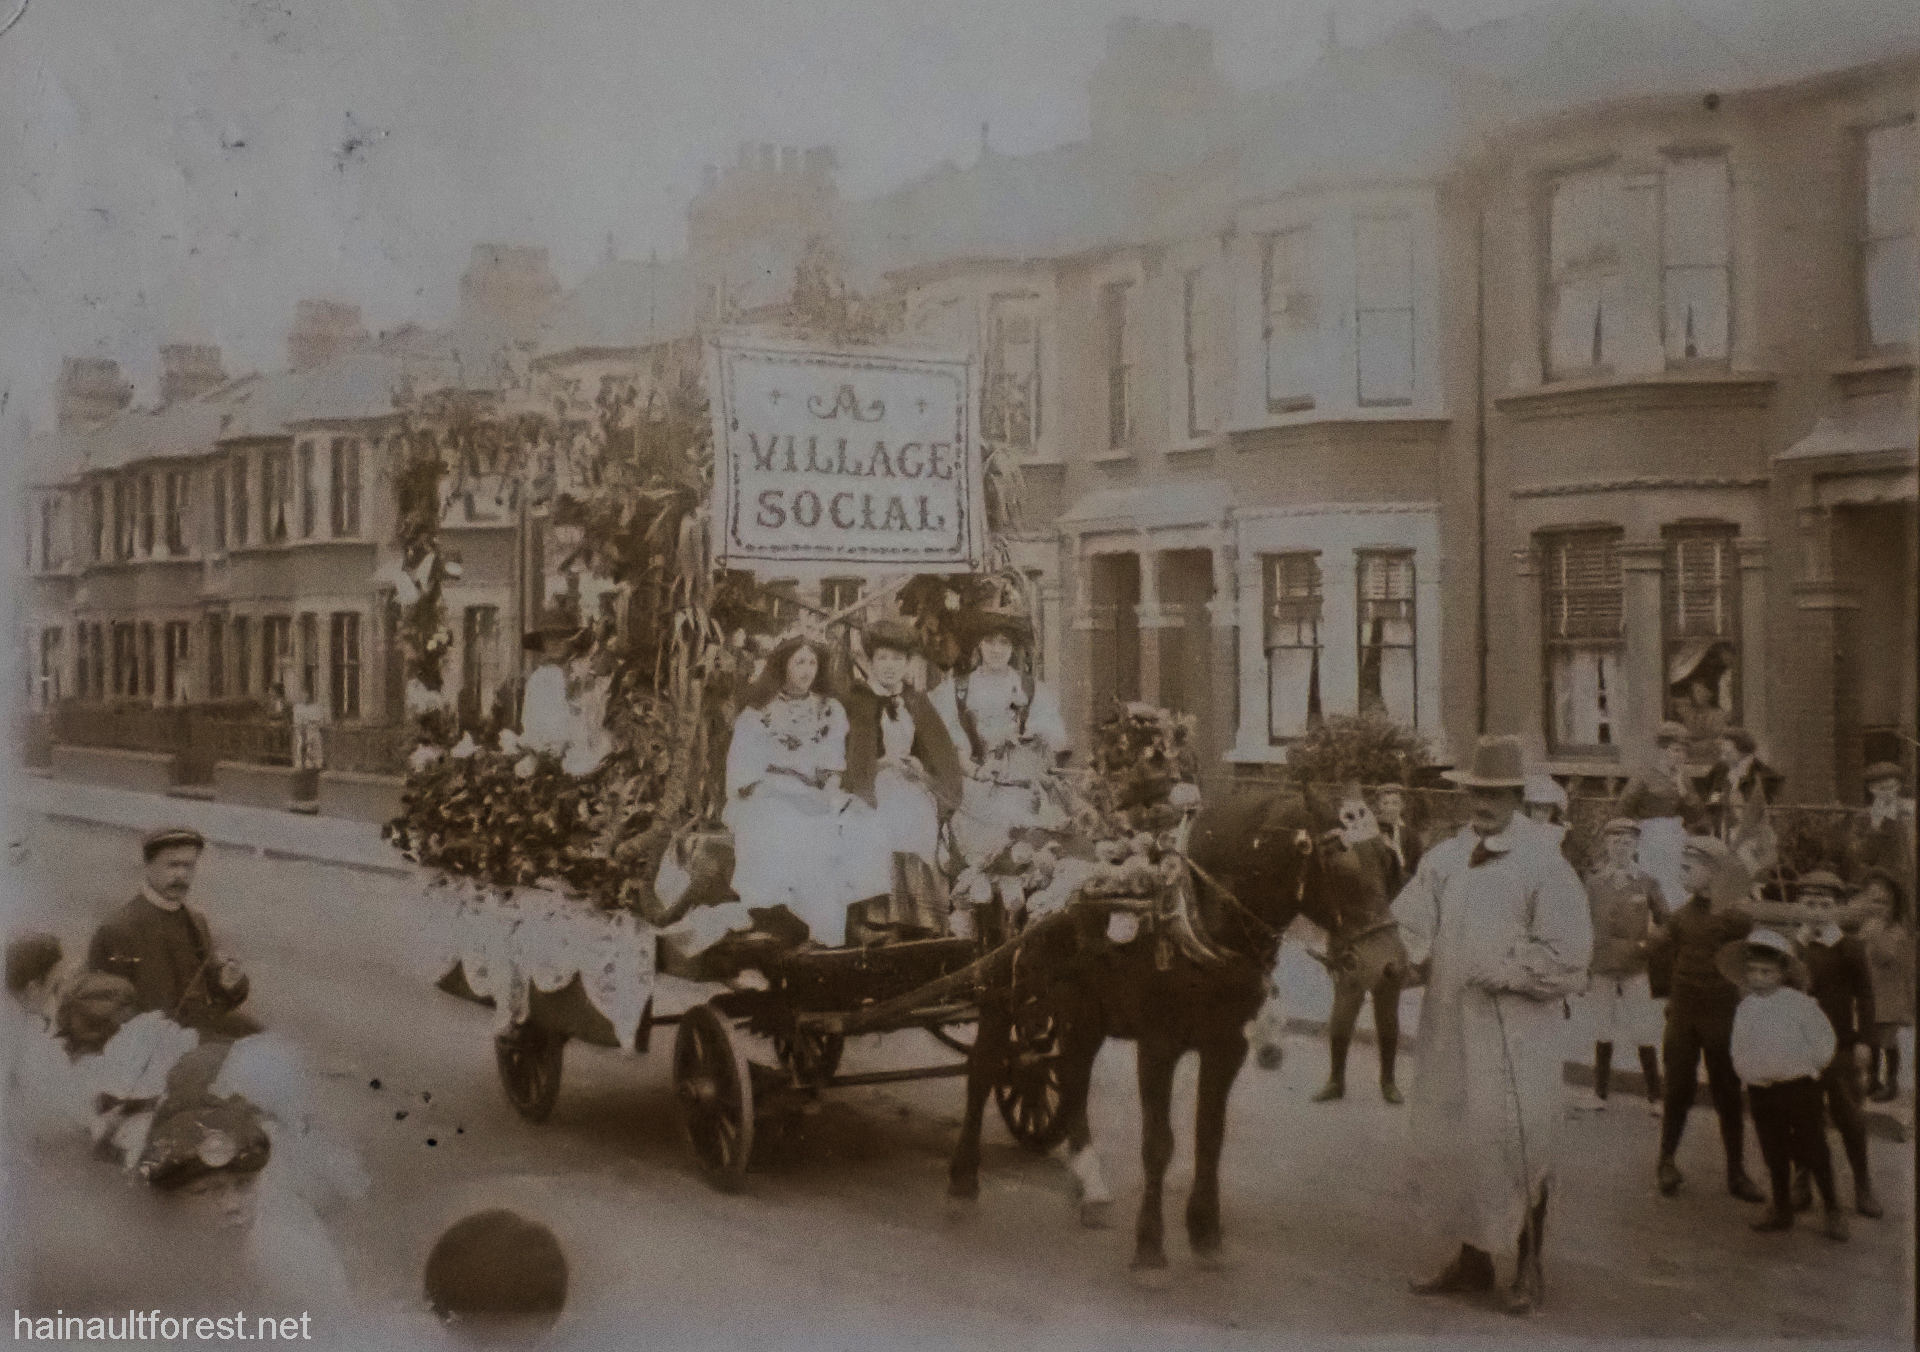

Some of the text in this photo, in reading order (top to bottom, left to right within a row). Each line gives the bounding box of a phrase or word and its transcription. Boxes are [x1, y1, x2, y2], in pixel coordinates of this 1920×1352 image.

[806, 383, 886, 422] A
[748, 432, 953, 480] VILLAGE
[756, 489, 945, 531] SOCIAL
